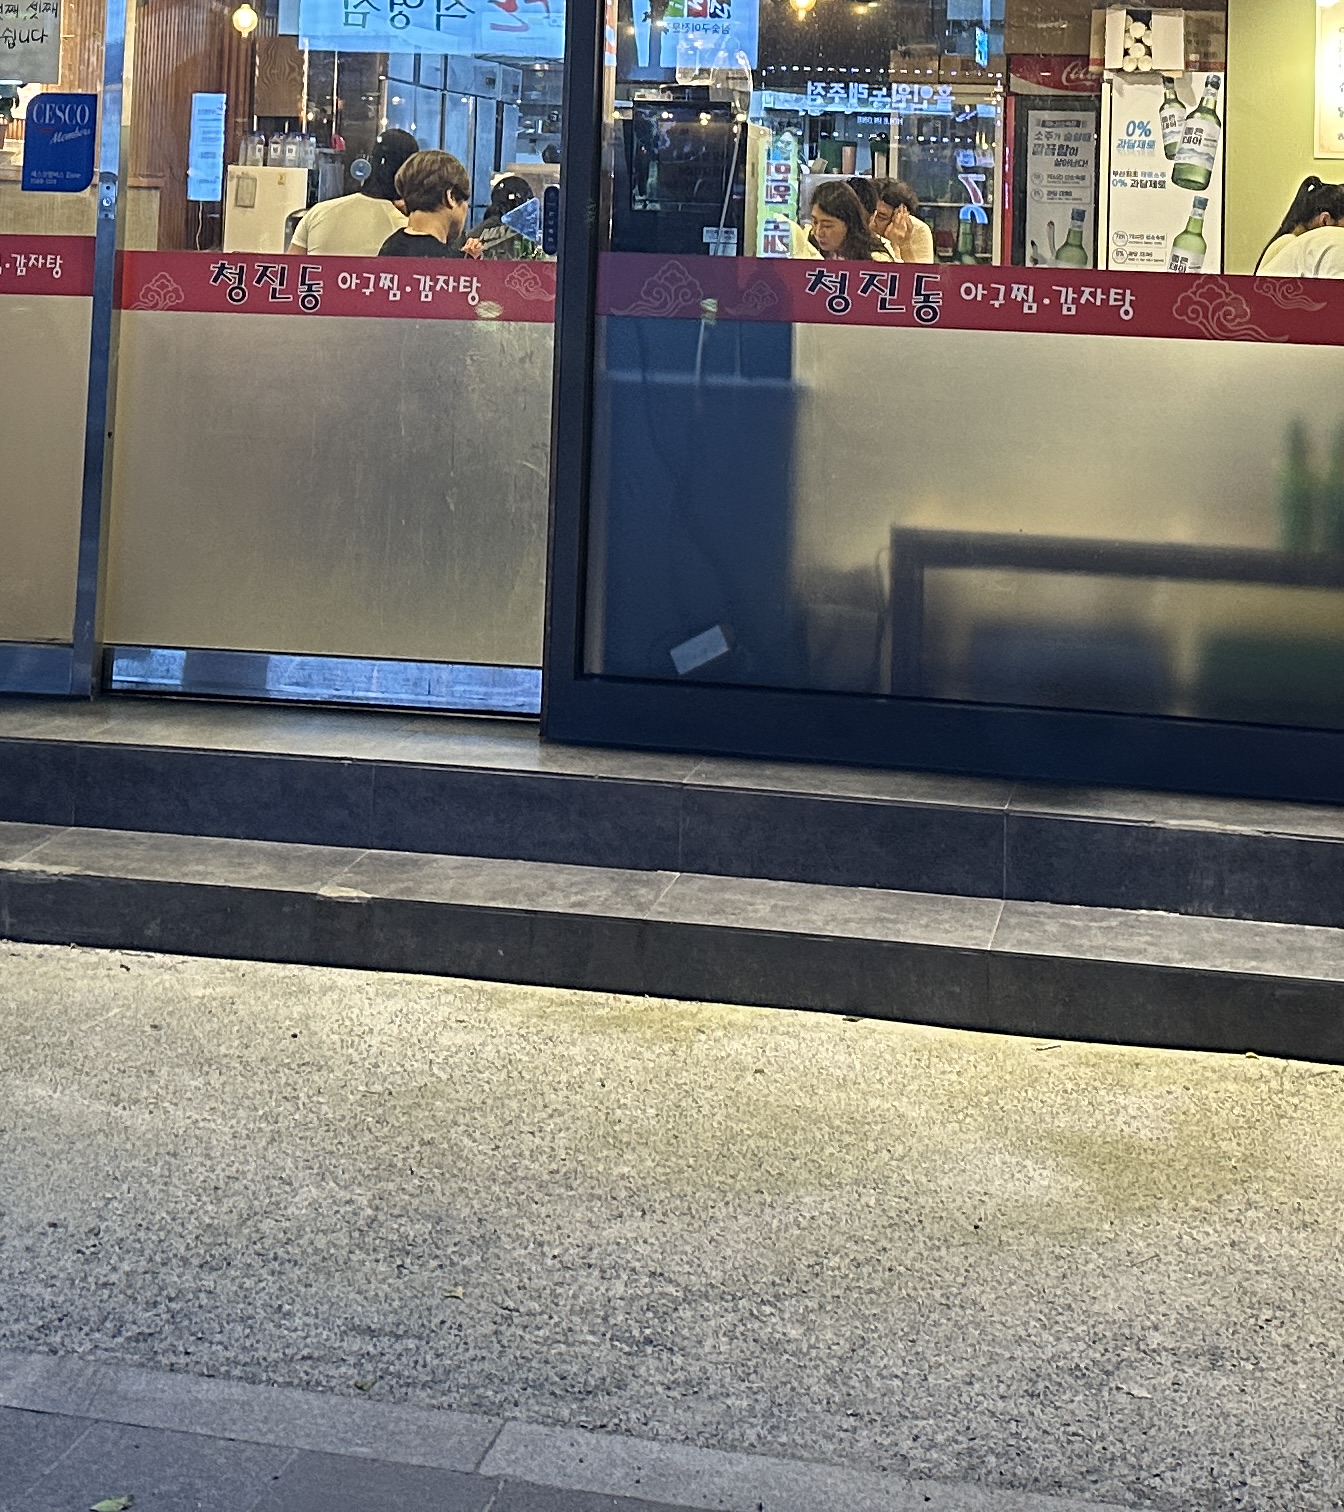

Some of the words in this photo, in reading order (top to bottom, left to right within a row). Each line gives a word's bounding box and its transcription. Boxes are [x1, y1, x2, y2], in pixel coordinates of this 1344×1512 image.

[32, 103, 90, 125] CESCO
[1126, 119, 1152, 138] 0%
[211, 261, 324, 312] 청진동
[806, 268, 943, 325] 청진동
